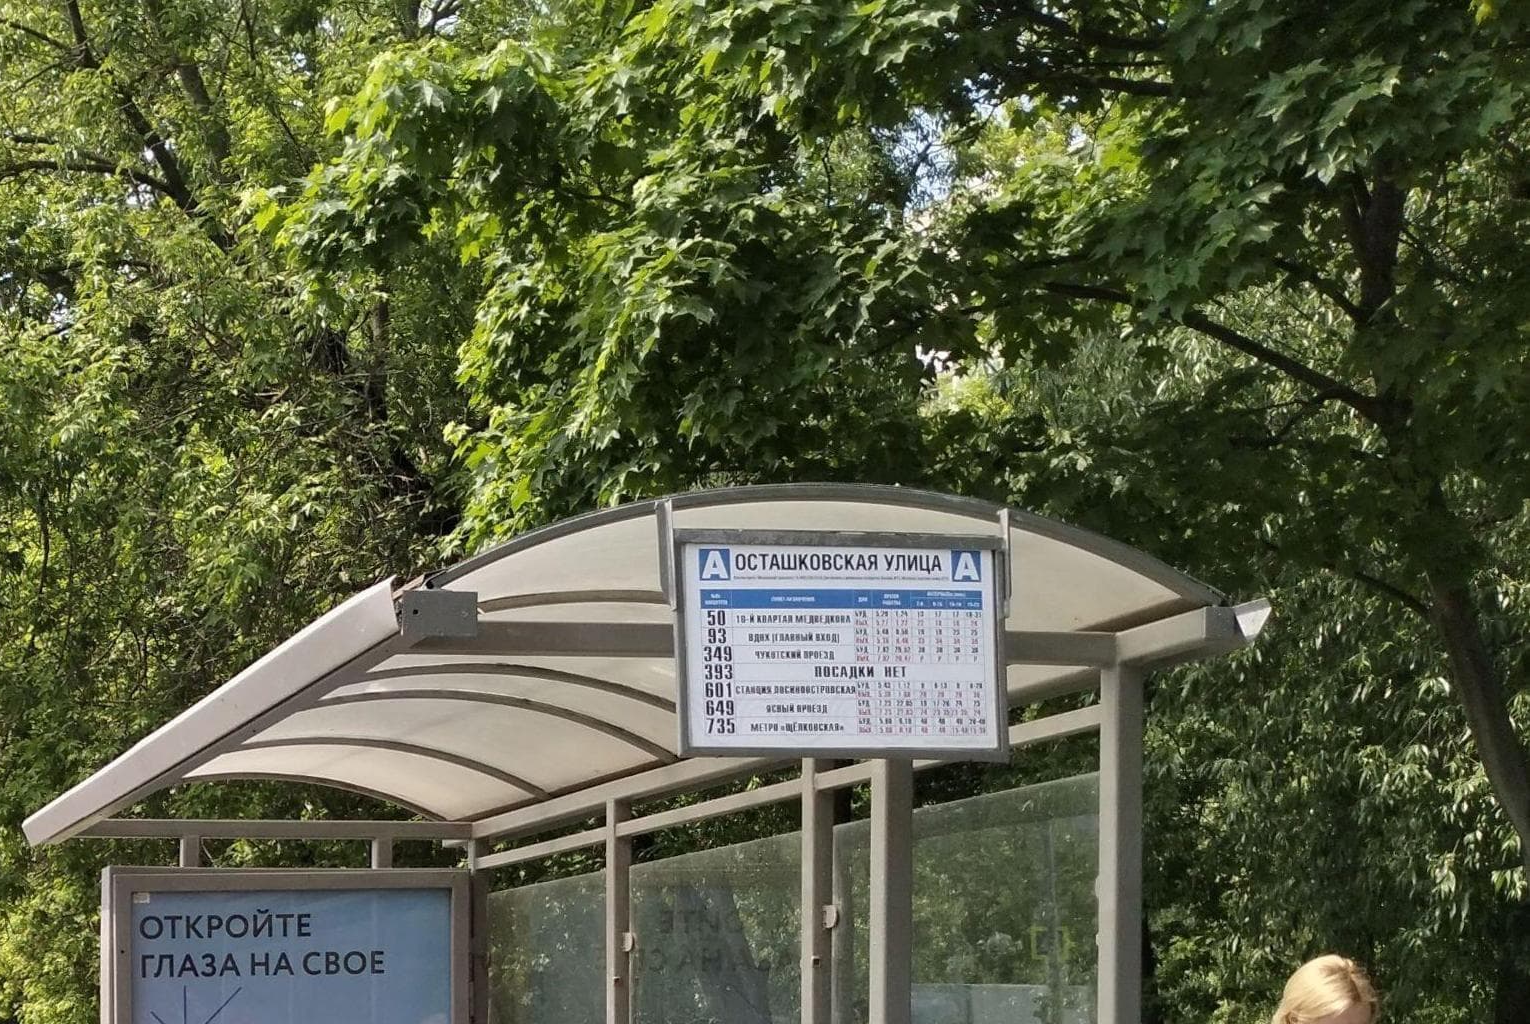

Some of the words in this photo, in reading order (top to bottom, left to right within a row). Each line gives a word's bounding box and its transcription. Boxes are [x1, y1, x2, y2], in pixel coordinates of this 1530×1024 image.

[735, 554, 878, 572] ОСТАШКОВСКАЯ
[885, 555, 942, 574] УЛИЦА
[707, 610, 726, 626] 50
[756, 615, 793, 624] КВАРТАЛ
[795, 615, 851, 624] МЕДВЕДКОВА
[708, 628, 727, 644] 93
[704, 646, 733, 662] 349
[804, 651, 835, 660] ПРОЕЗД
[705, 664, 733, 680] 393
[814, 665, 874, 679] ПОСАДКИ
[884, 666, 906, 678] НЕТ
[705, 682, 732, 698] 601
[706, 700, 735, 716] 649
[797, 704, 828, 714] ПРОЕЗД
[707, 718, 735, 734] 735
[751, 723, 779, 732] МЕТРО
[139, 909, 312, 940] ОТКРОЙТЕ
[140, 953, 241, 978] ГЛАЗА
[250, 953, 294, 976] НА
[302, 950, 386, 976] СВОЕ
